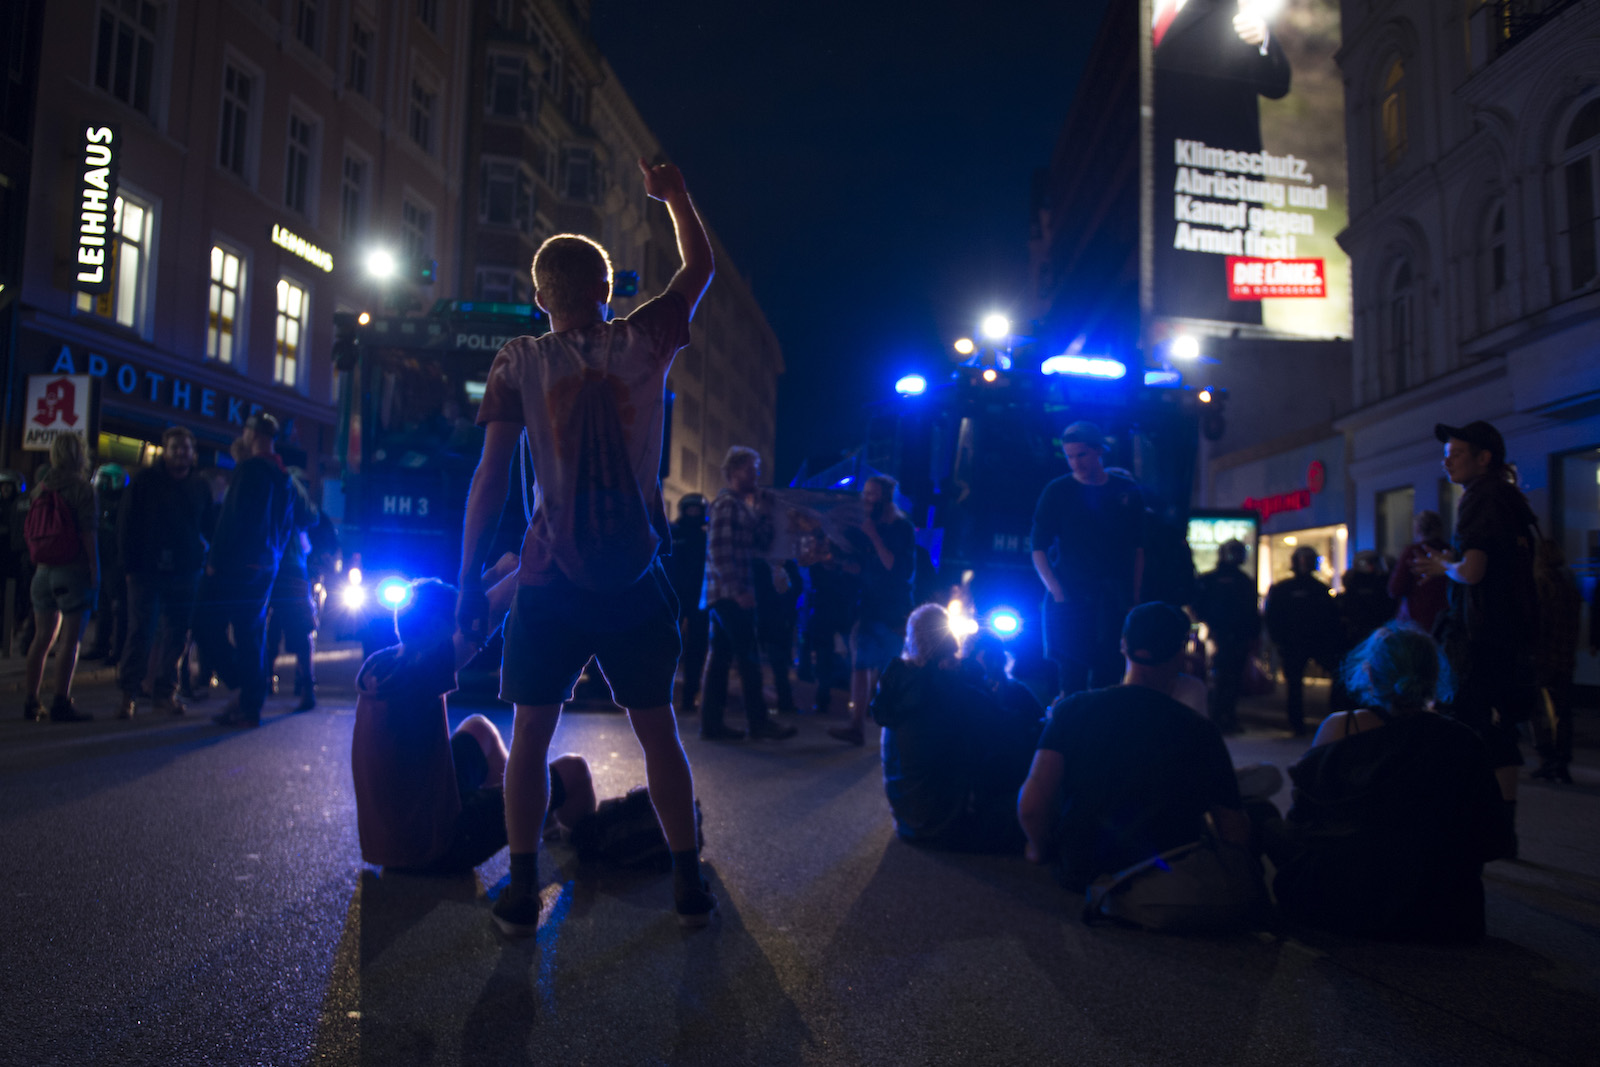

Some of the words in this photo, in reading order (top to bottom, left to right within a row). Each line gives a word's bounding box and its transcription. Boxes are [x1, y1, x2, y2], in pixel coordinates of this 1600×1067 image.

[1174, 138, 1313, 183] Klimaschutz,
[77, 126, 113, 284] LEIHHAUS
[1174, 166, 1285, 208] Abrüstung
[1287, 184, 1328, 210] und
[1174, 194, 1247, 230] Kampf
[1248, 206, 1315, 235] gegen
[1173, 222, 1243, 256] Armut
[1233, 262, 1264, 286] DIE
[383, 495, 412, 515] HH
[417, 497, 430, 516] 3
